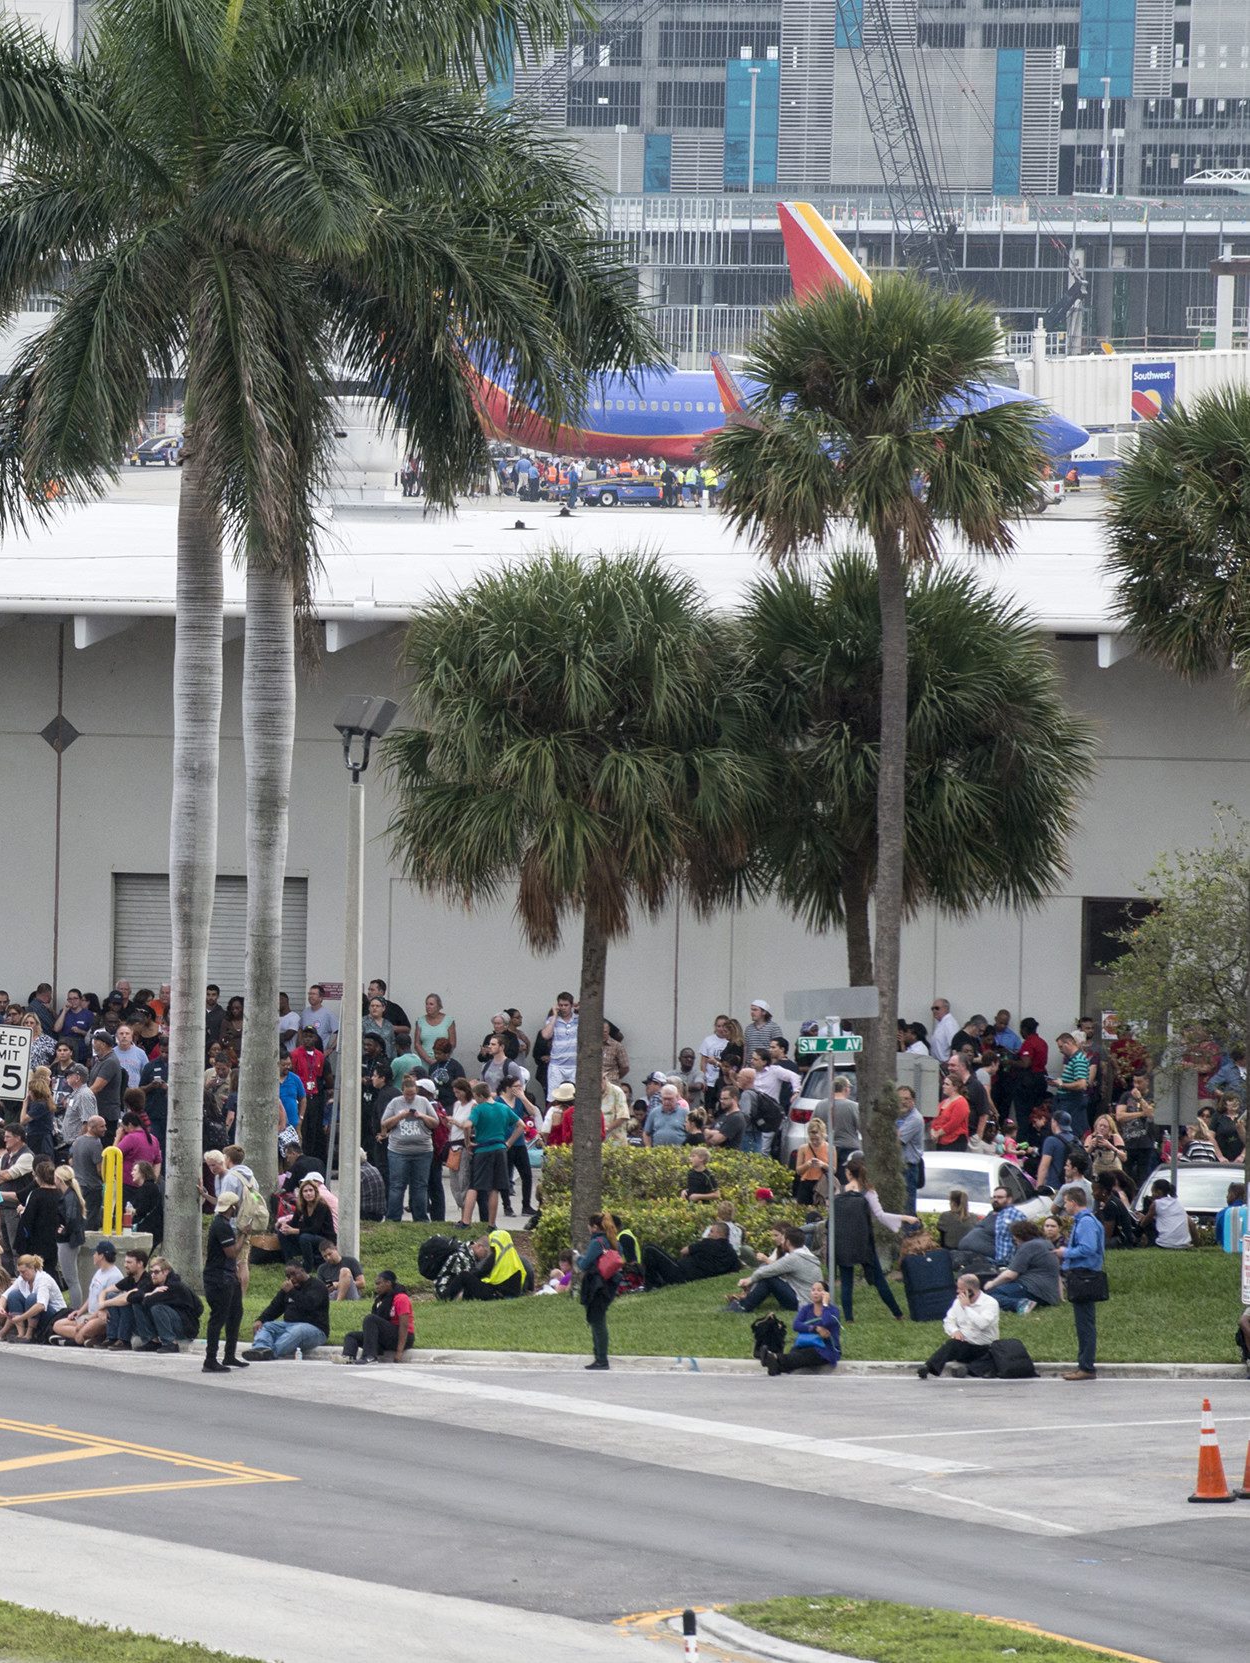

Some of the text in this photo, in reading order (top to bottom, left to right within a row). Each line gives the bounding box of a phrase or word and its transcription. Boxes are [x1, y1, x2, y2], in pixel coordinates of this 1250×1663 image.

[1133, 371, 1171, 380] Southwest
[800, 1038, 860, 1051] SW 2 AV
